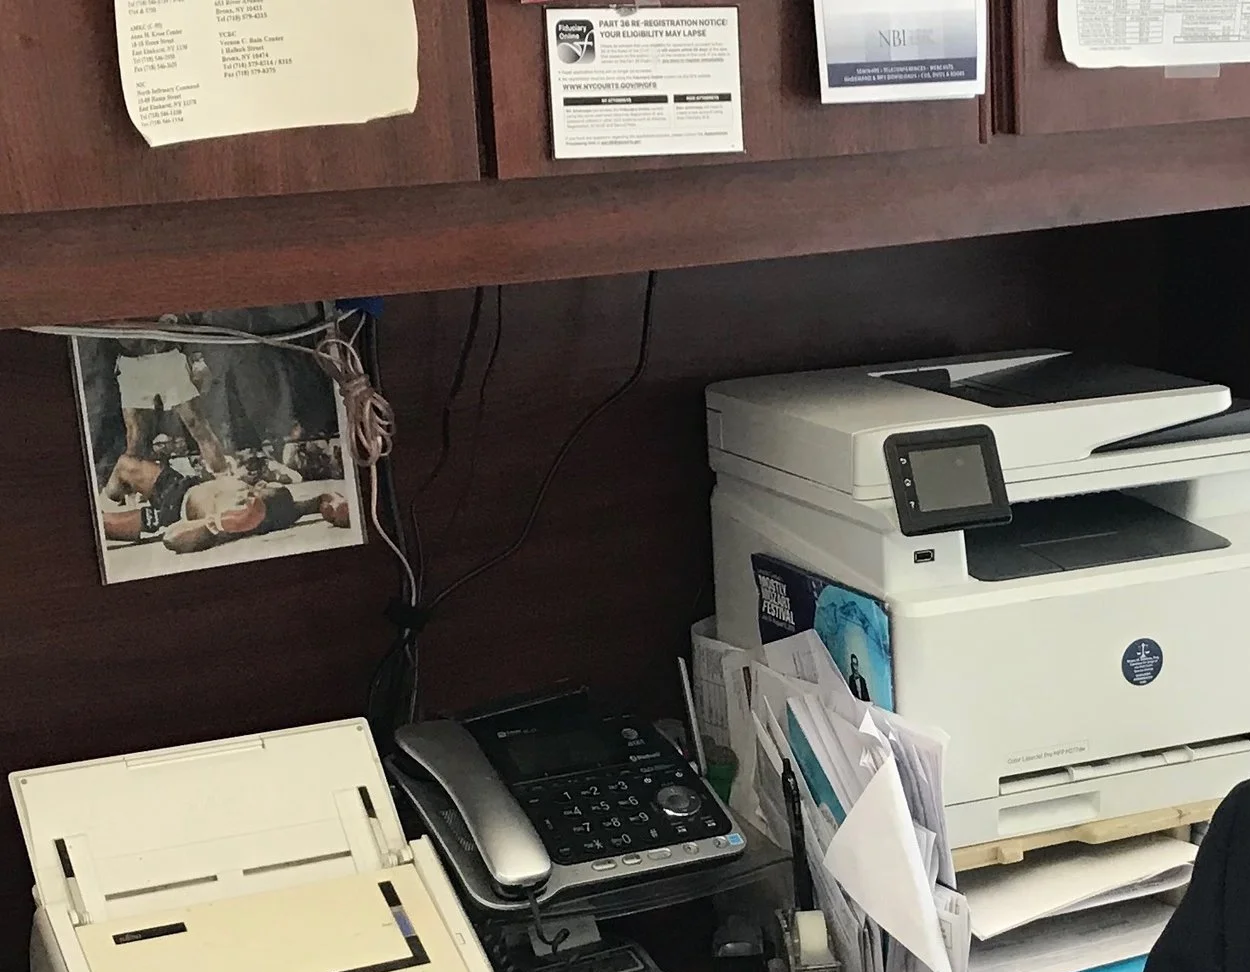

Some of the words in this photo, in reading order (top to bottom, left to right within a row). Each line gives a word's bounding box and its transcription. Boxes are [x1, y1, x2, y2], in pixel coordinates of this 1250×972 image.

[558, 24, 587, 33] Fiduciary
[599, 20, 619, 28] PART
[620, 20, 630, 28] 36
[631, 19, 698, 28] RE-REGISTRATION
[599, 30, 621, 38] YOUR
[622, 29, 664, 38] ELIGIBILITY
[665, 29, 681, 37] MAY
[682, 29, 706, 37] LAPSE
[878, 29, 907, 47] NBI
[758, 574, 786, 596] MOSTLY
[761, 588, 790, 610] MOZART
[763, 600, 795, 626] FESTIVAL
[563, 791, 572, 800] 1
[589, 786, 600, 796] 2
[618, 781, 628, 790] 3
[573, 806, 582, 815] 4
[600, 801, 610, 811] 5
[628, 796, 639, 806] 6
[582, 822, 590, 832] 7
[610, 817, 621, 827] 8
[639, 812, 649, 822] 9
[621, 833, 631, 844] 0
